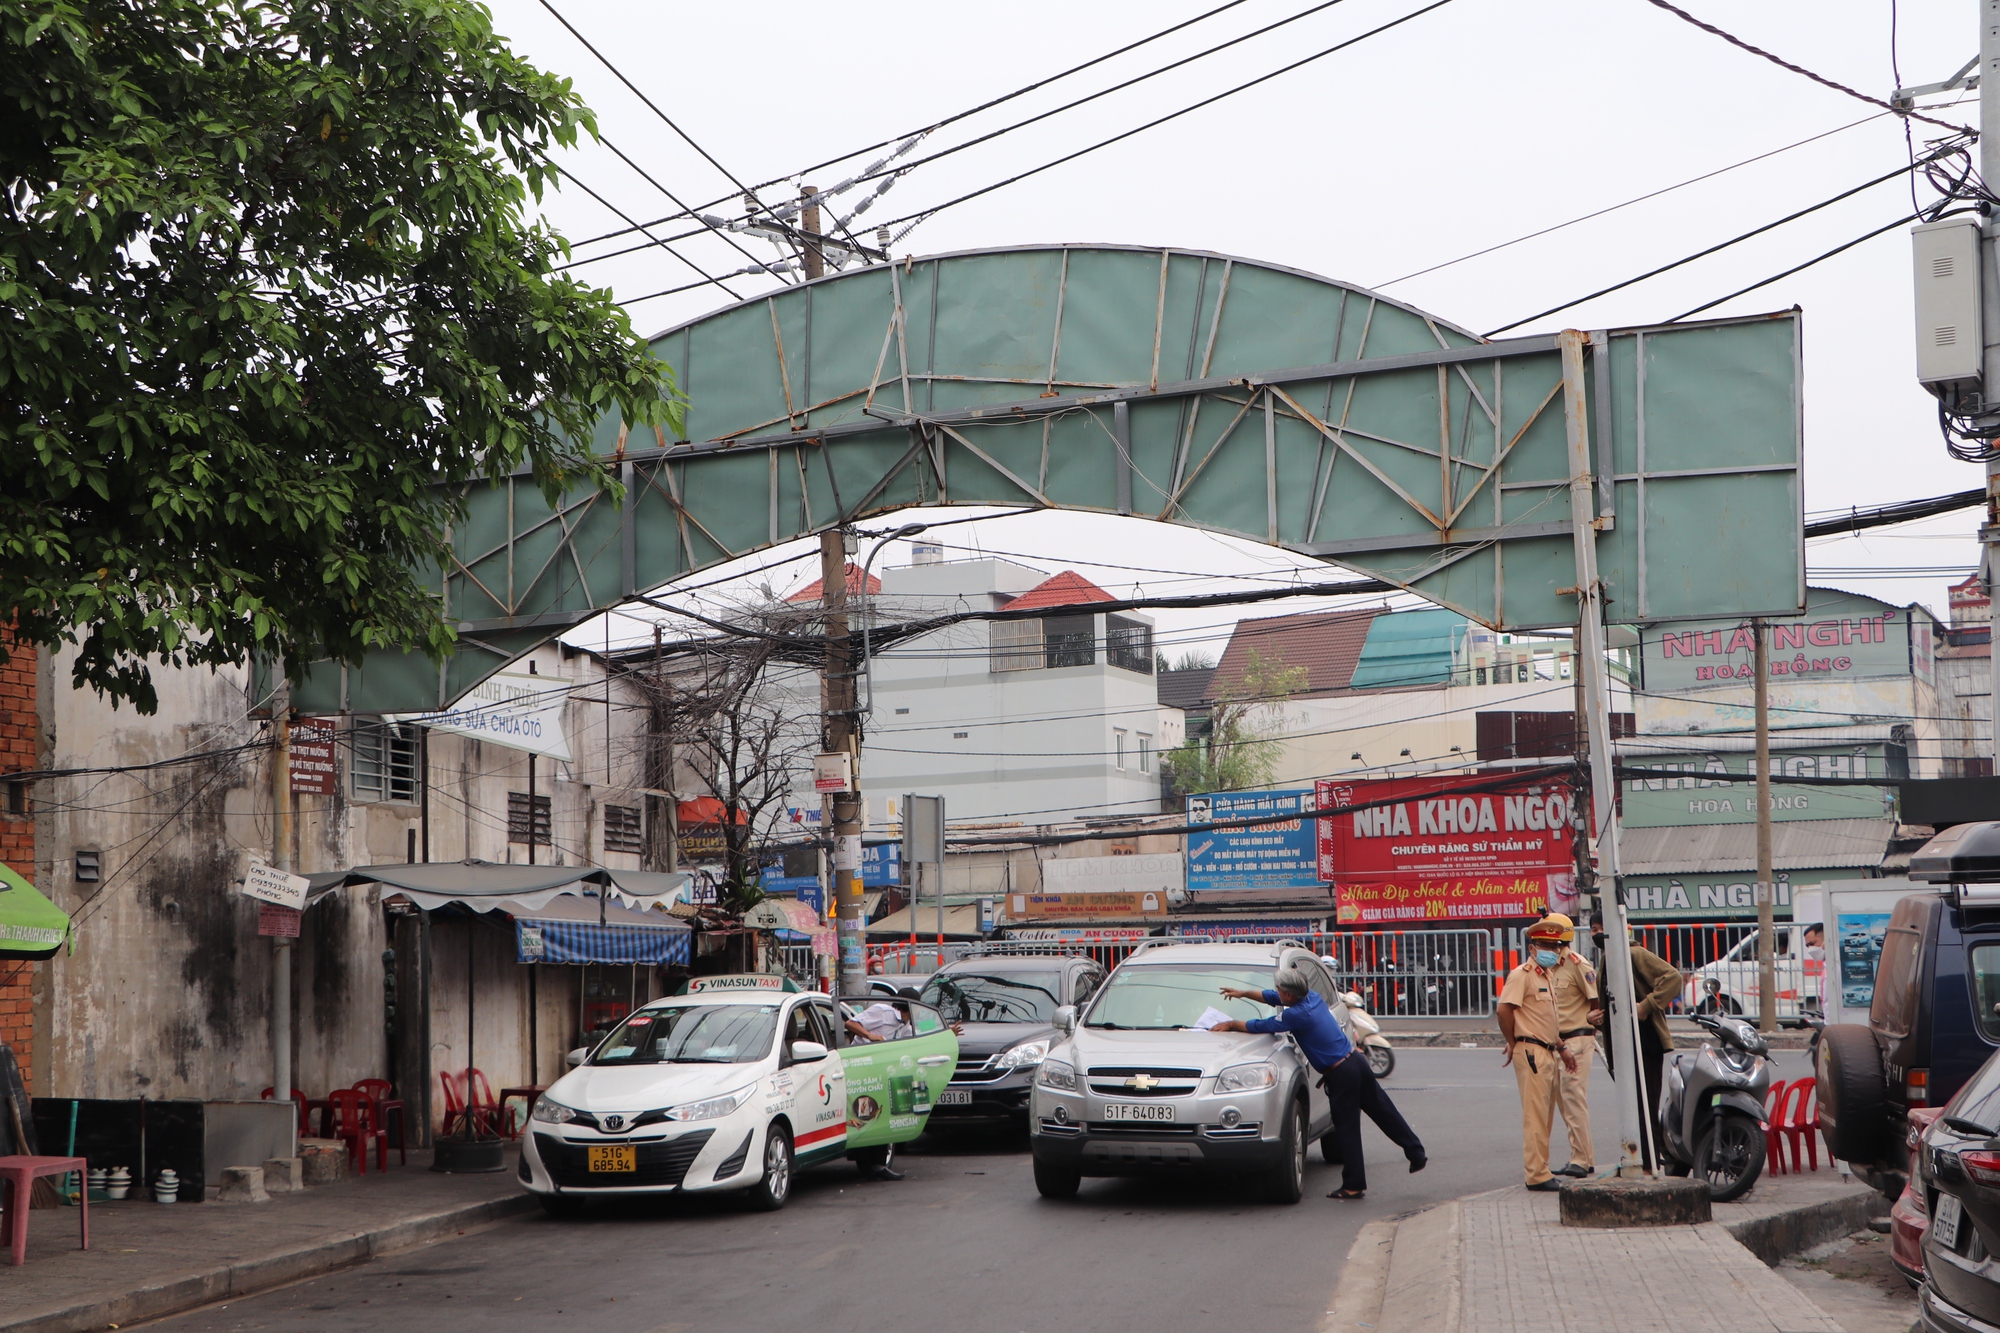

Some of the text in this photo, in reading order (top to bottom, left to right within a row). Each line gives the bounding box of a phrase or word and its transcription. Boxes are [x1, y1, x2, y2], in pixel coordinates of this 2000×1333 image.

[1772, 611, 1896, 651] NGHỈ
[1696, 653, 1852, 681] HOA HỒNG
[465, 703, 487, 731] SỬA
[522, 715, 543, 738] ÔTÔ
[1234, 797, 1256, 811] HÀNG
[1277, 796, 1296, 809] KÍNH
[1688, 799, 1734, 814] HOA
[1353, 800, 1412, 838] NHA
[1418, 797, 1498, 836] KHOA
[1391, 843, 1436, 856] CHUYÊN
[1438, 842, 1470, 854] RĂNG
[1490, 837, 1523, 852] THẨM
[1525, 839, 1544, 851] MỸ
[1341, 884, 1380, 902] Nhân
[1413, 881, 1449, 899] Noel
[1452, 882, 1465, 898] &
[1469, 878, 1504, 897] Năm
[1623, 879, 1692, 911] NHÀ
[1382, 905, 1395, 919] GIÁ
[1425, 899, 1448, 918] 20%
[1458, 903, 1473, 916] CÁC
[1503, 901, 1524, 915] KHÁC
[1525, 896, 1548, 914] 10%
[1019, 930, 1057, 941] Coffee
[1085, 930, 1101, 938] AN
[710, 978, 780, 988] VINASUN TAXI
[847, 1084, 868, 1095] GUYÊN
[936, 1092, 970, 1104] -031.81
[816, 1109, 836, 1123] VINASUN
[889, 1116, 919, 1129] SHINSAM
[601, 1147, 623, 1159] 51G
[593, 1159, 631, 1171] 685.94
